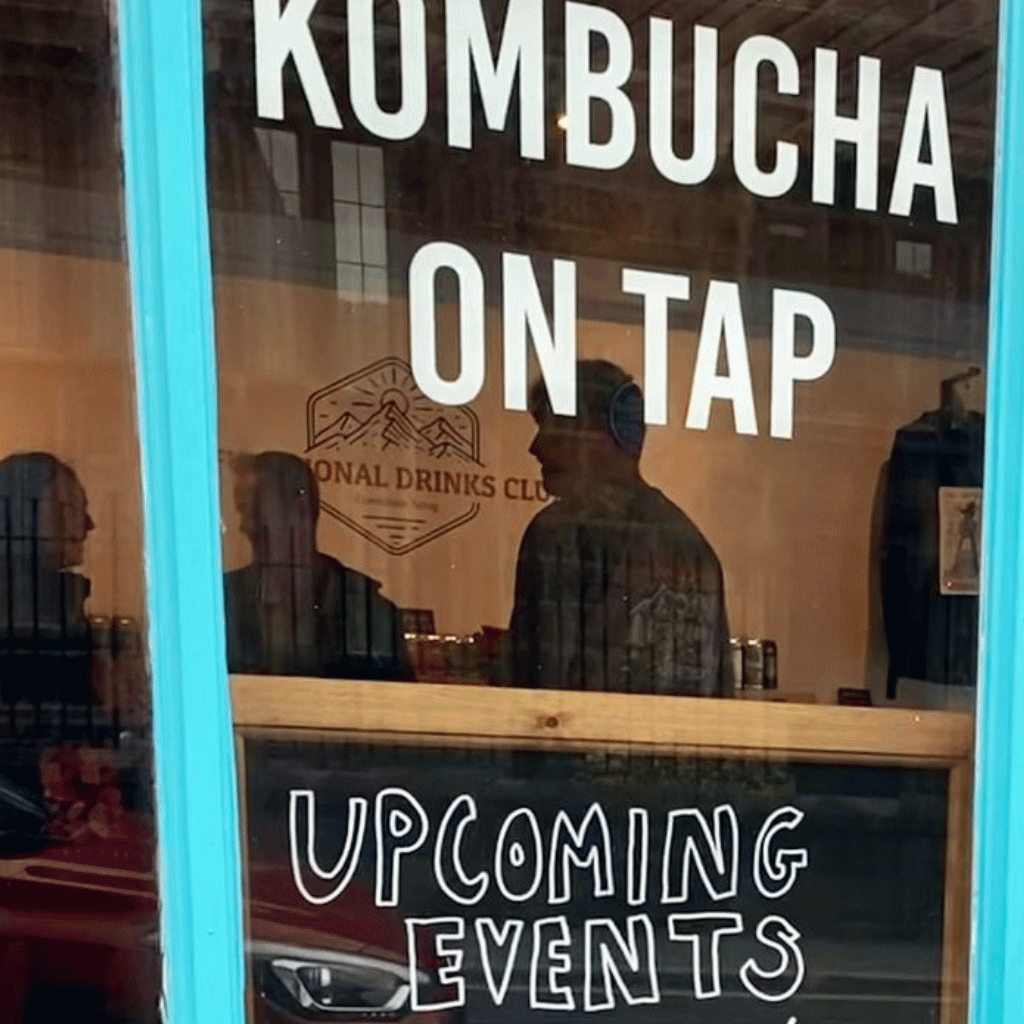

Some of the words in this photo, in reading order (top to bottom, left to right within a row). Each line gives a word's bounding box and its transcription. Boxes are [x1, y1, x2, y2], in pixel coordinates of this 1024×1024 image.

[253, 0, 958, 224] KOMBUCHA
[408, 241, 577, 417] ON
[622, 268, 836, 440] TAP
[396, 465, 496, 499] DRINKS
[289, 788, 807, 906] UPCOMING
[404, 914, 804, 1011] EVENTS
